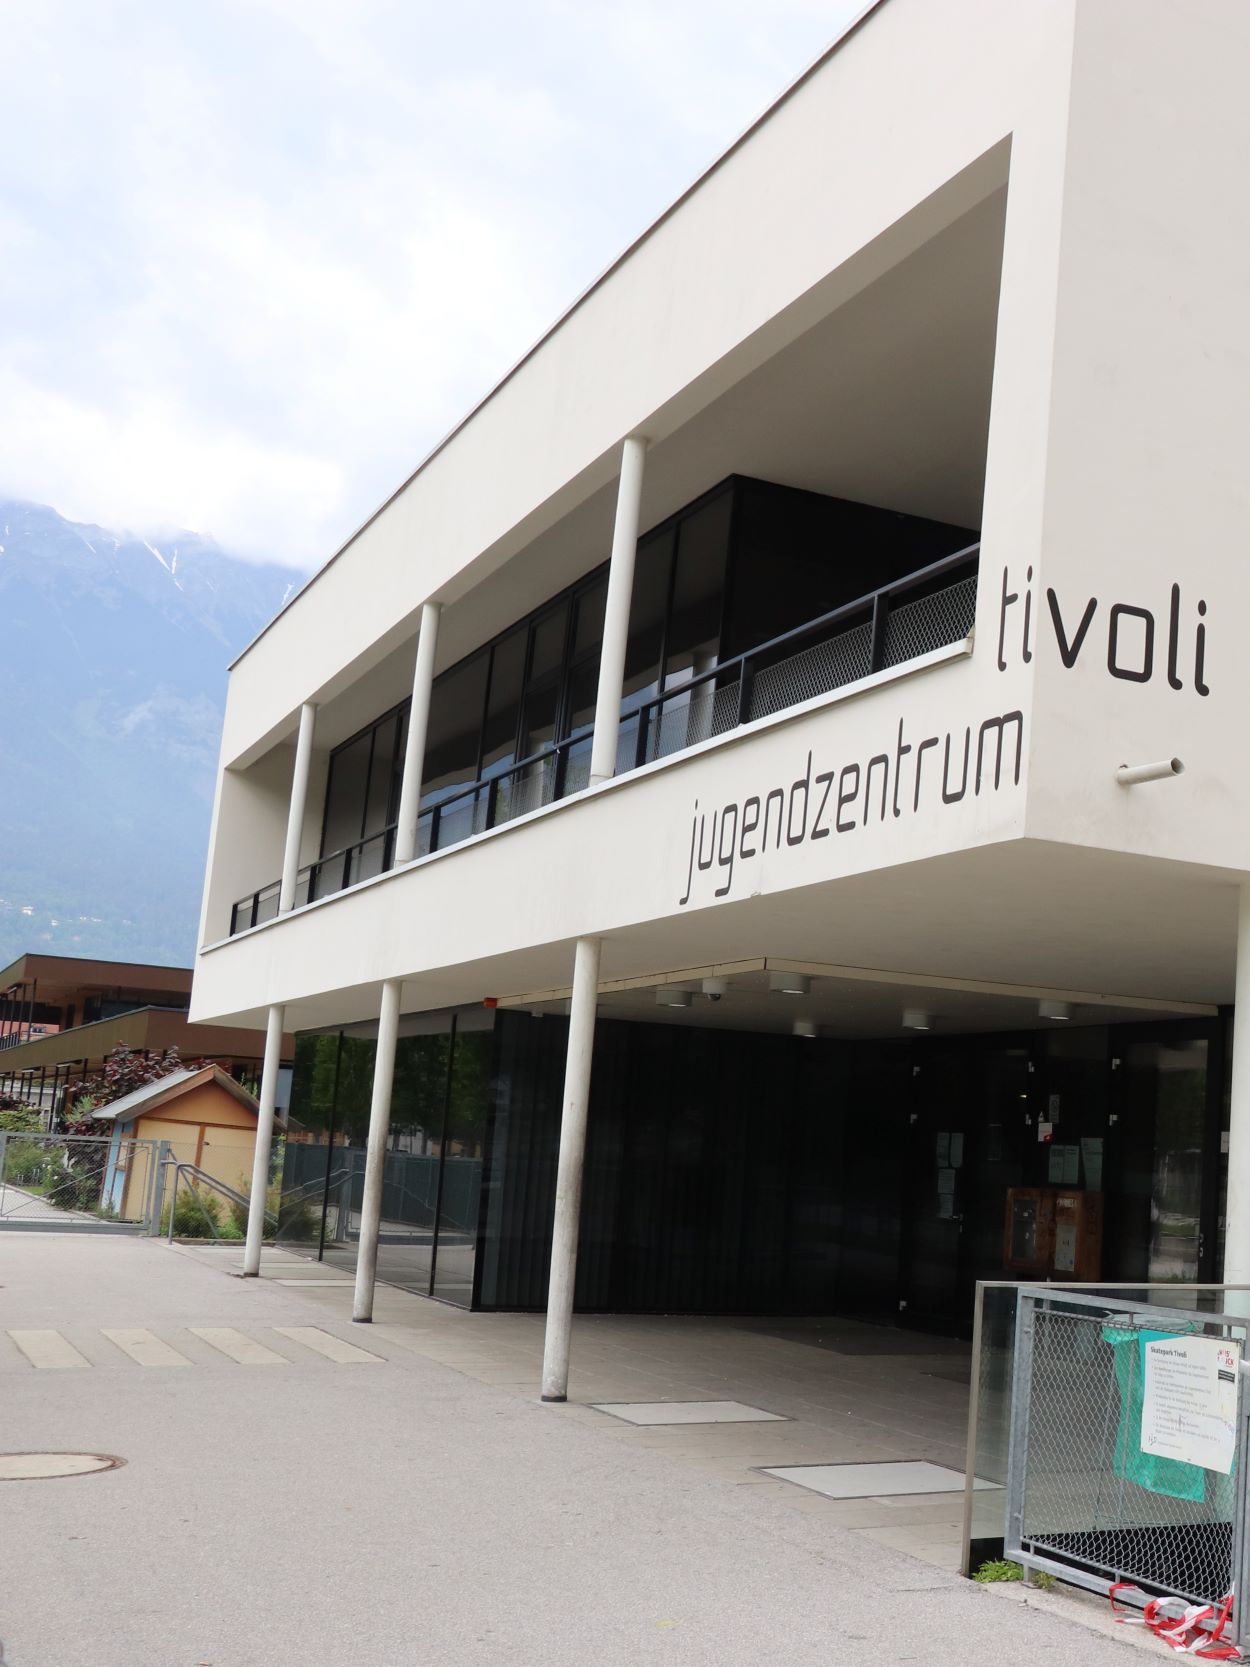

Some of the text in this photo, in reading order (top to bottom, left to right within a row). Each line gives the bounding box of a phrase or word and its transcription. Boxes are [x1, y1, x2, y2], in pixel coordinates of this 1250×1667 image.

[998, 565, 1211, 698] tivoli
[679, 709, 1024, 907] jugendzentrum
[1150, 1346, 1174, 1358] Skatepark
